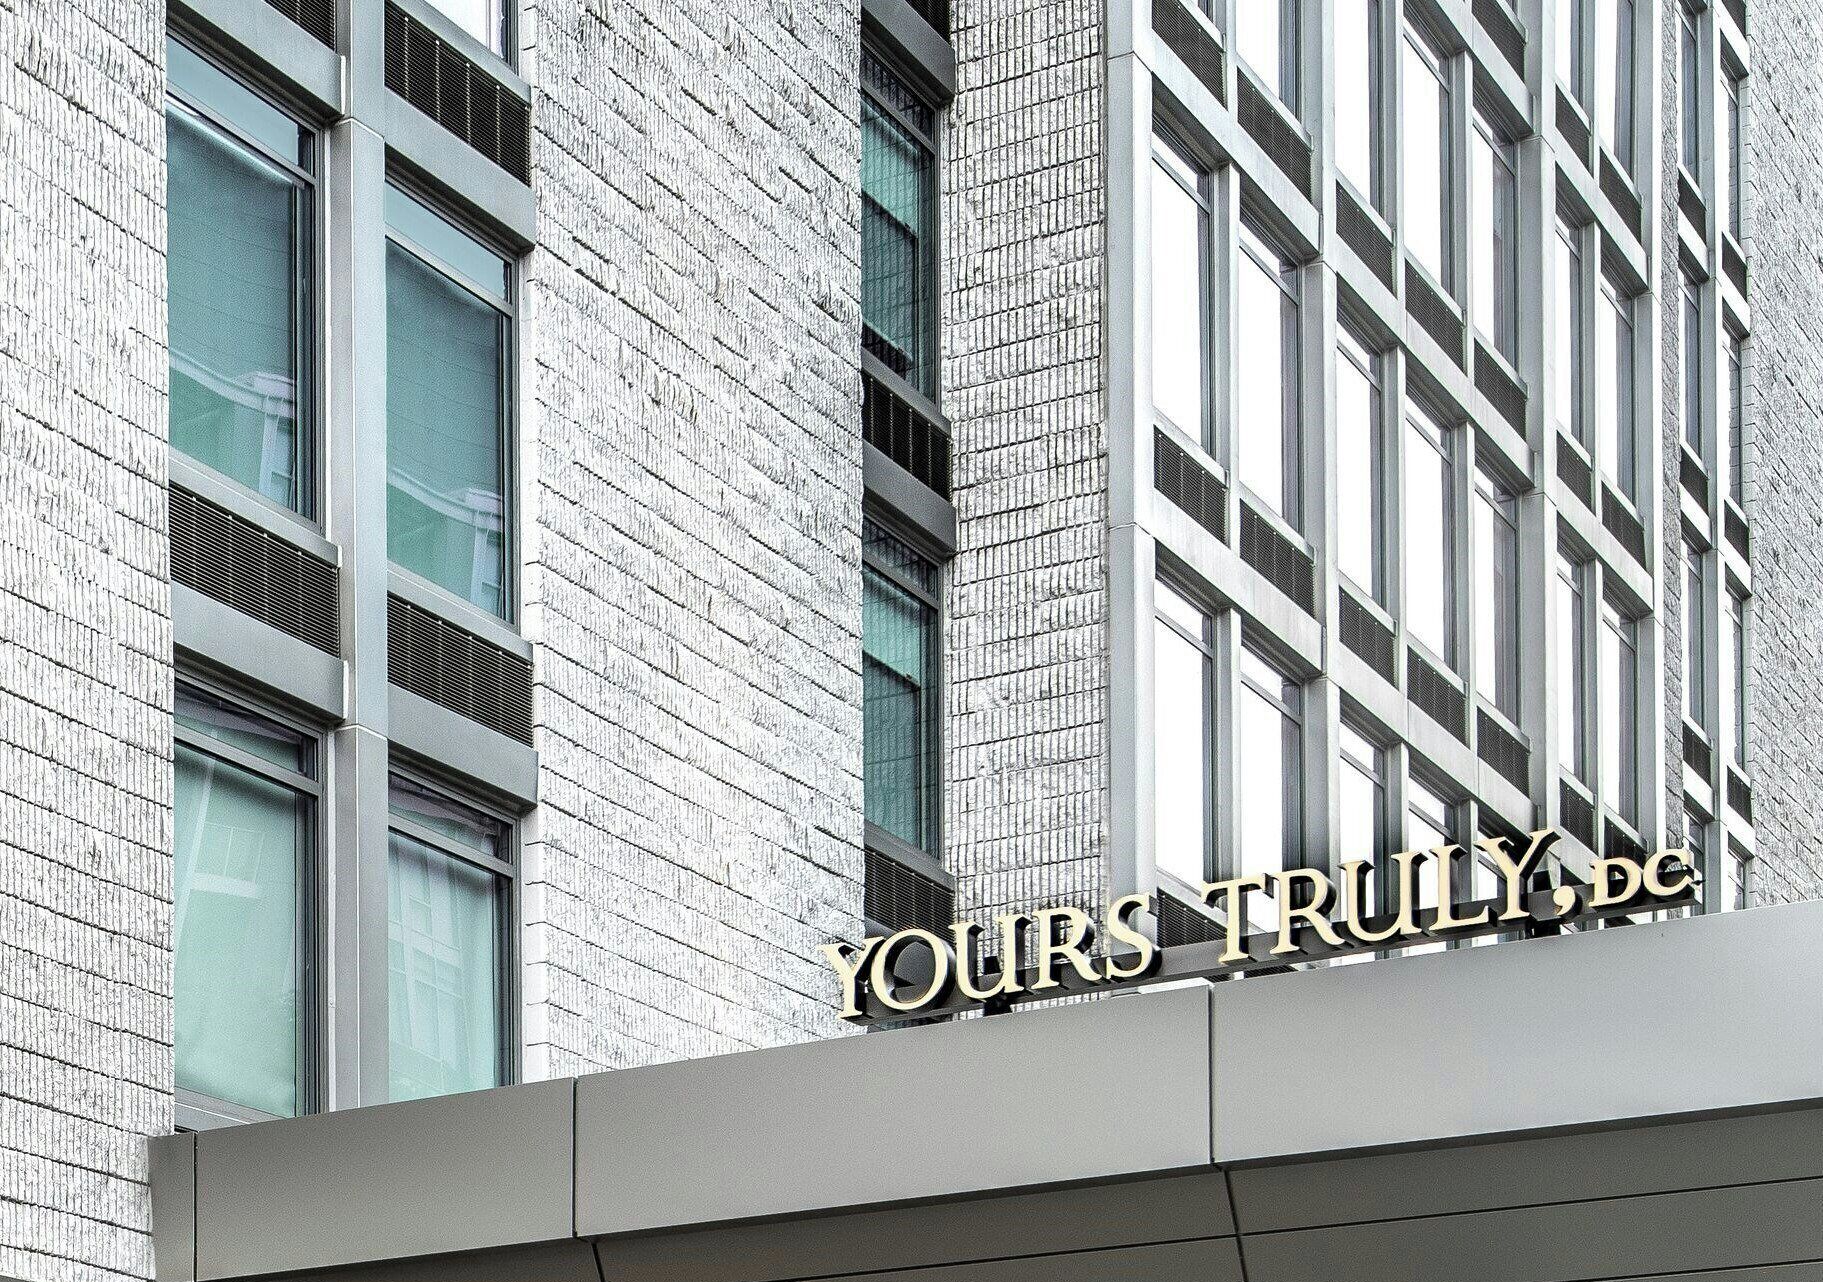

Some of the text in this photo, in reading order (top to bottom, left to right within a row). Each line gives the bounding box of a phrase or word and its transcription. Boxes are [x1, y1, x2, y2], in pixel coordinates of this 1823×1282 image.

[817, 828, 1696, 1020] YOURS TRULY, DC
